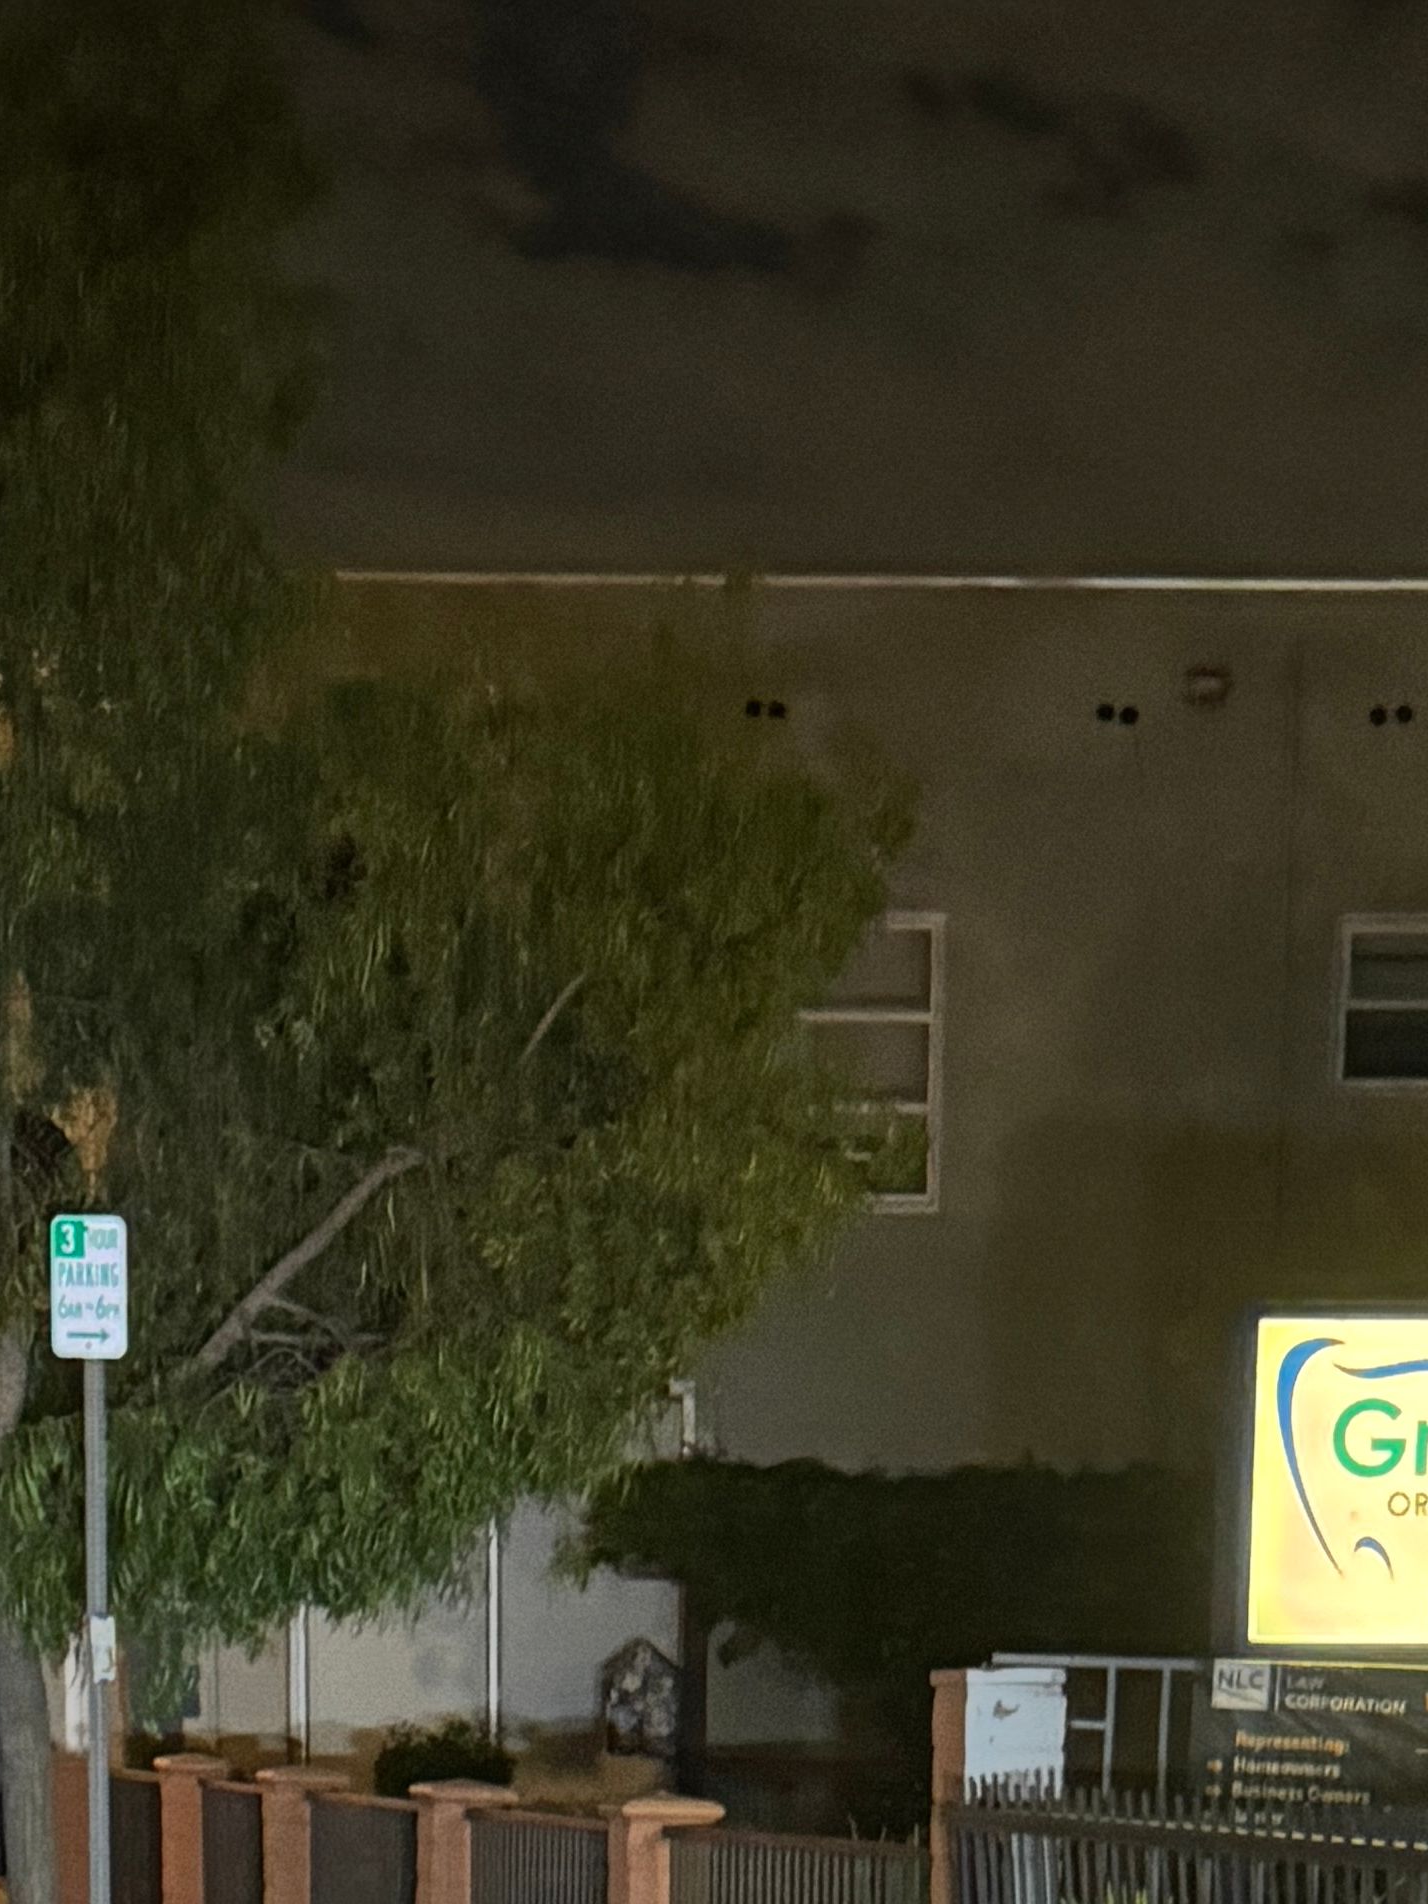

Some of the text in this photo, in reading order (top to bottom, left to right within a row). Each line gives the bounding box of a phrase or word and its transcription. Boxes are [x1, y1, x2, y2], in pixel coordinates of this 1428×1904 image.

[59, 1222, 76, 1254] 3
[57, 1262, 120, 1288] PARKING
[1218, 1664, 1265, 1691] NLC
[1284, 1692, 1407, 1717] CORPORATION
